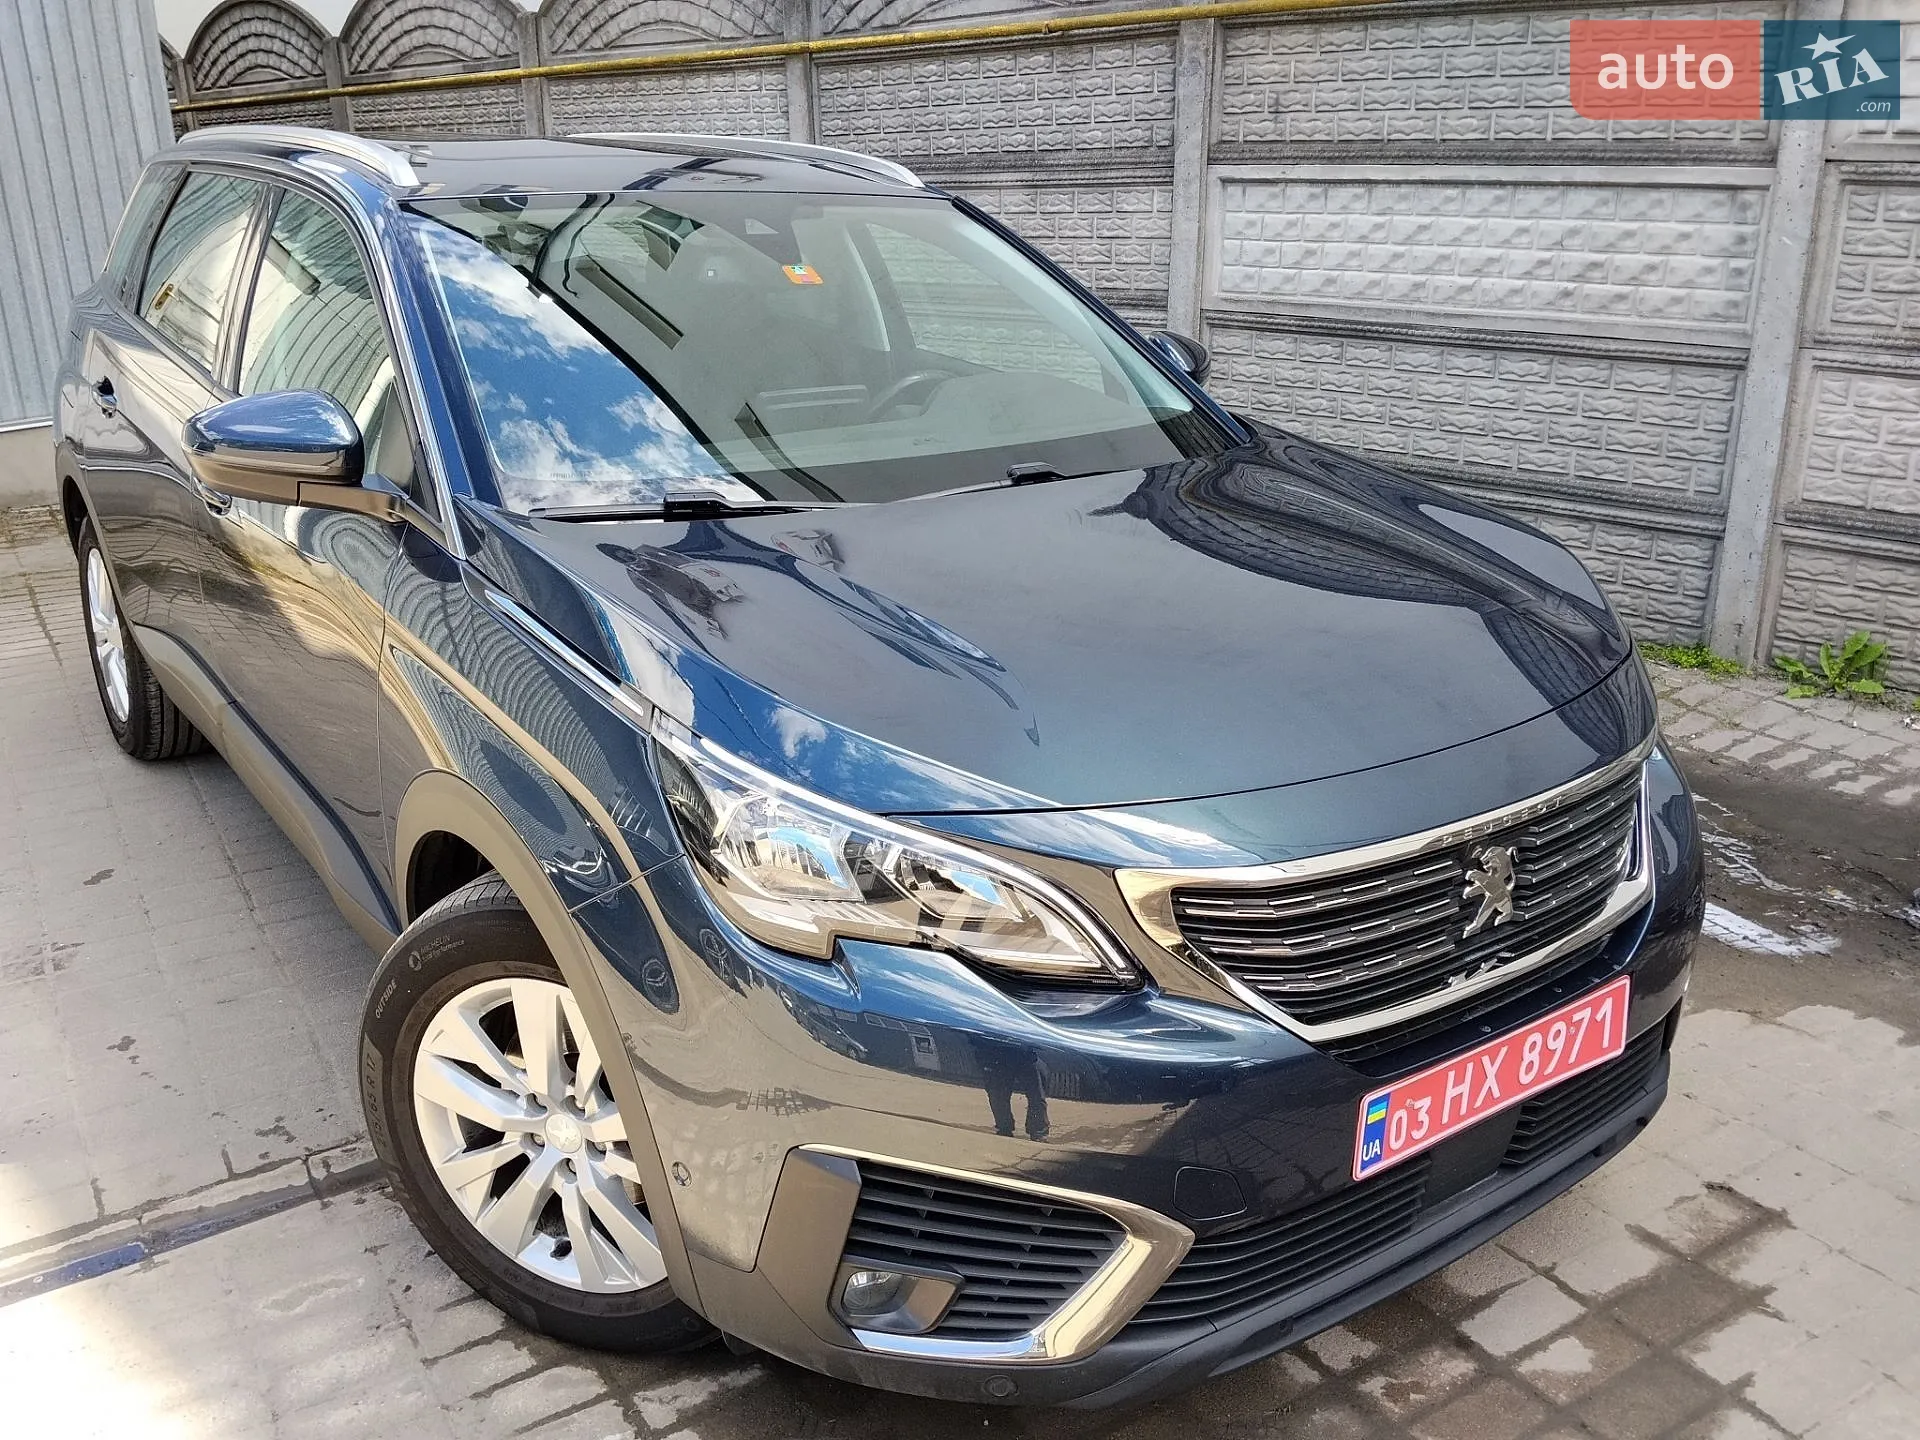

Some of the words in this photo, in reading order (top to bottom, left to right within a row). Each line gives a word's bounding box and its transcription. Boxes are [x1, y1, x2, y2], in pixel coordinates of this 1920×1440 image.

[1442, 796, 1562, 847] PEUGEOT
[375, 979, 397, 1019] OUTSIDE
[1388, 1096, 1432, 1151] 03
[1441, 1046, 1508, 1125] HX
[1518, 997, 1613, 1085] 8971
[1362, 1138, 1381, 1161] UA
